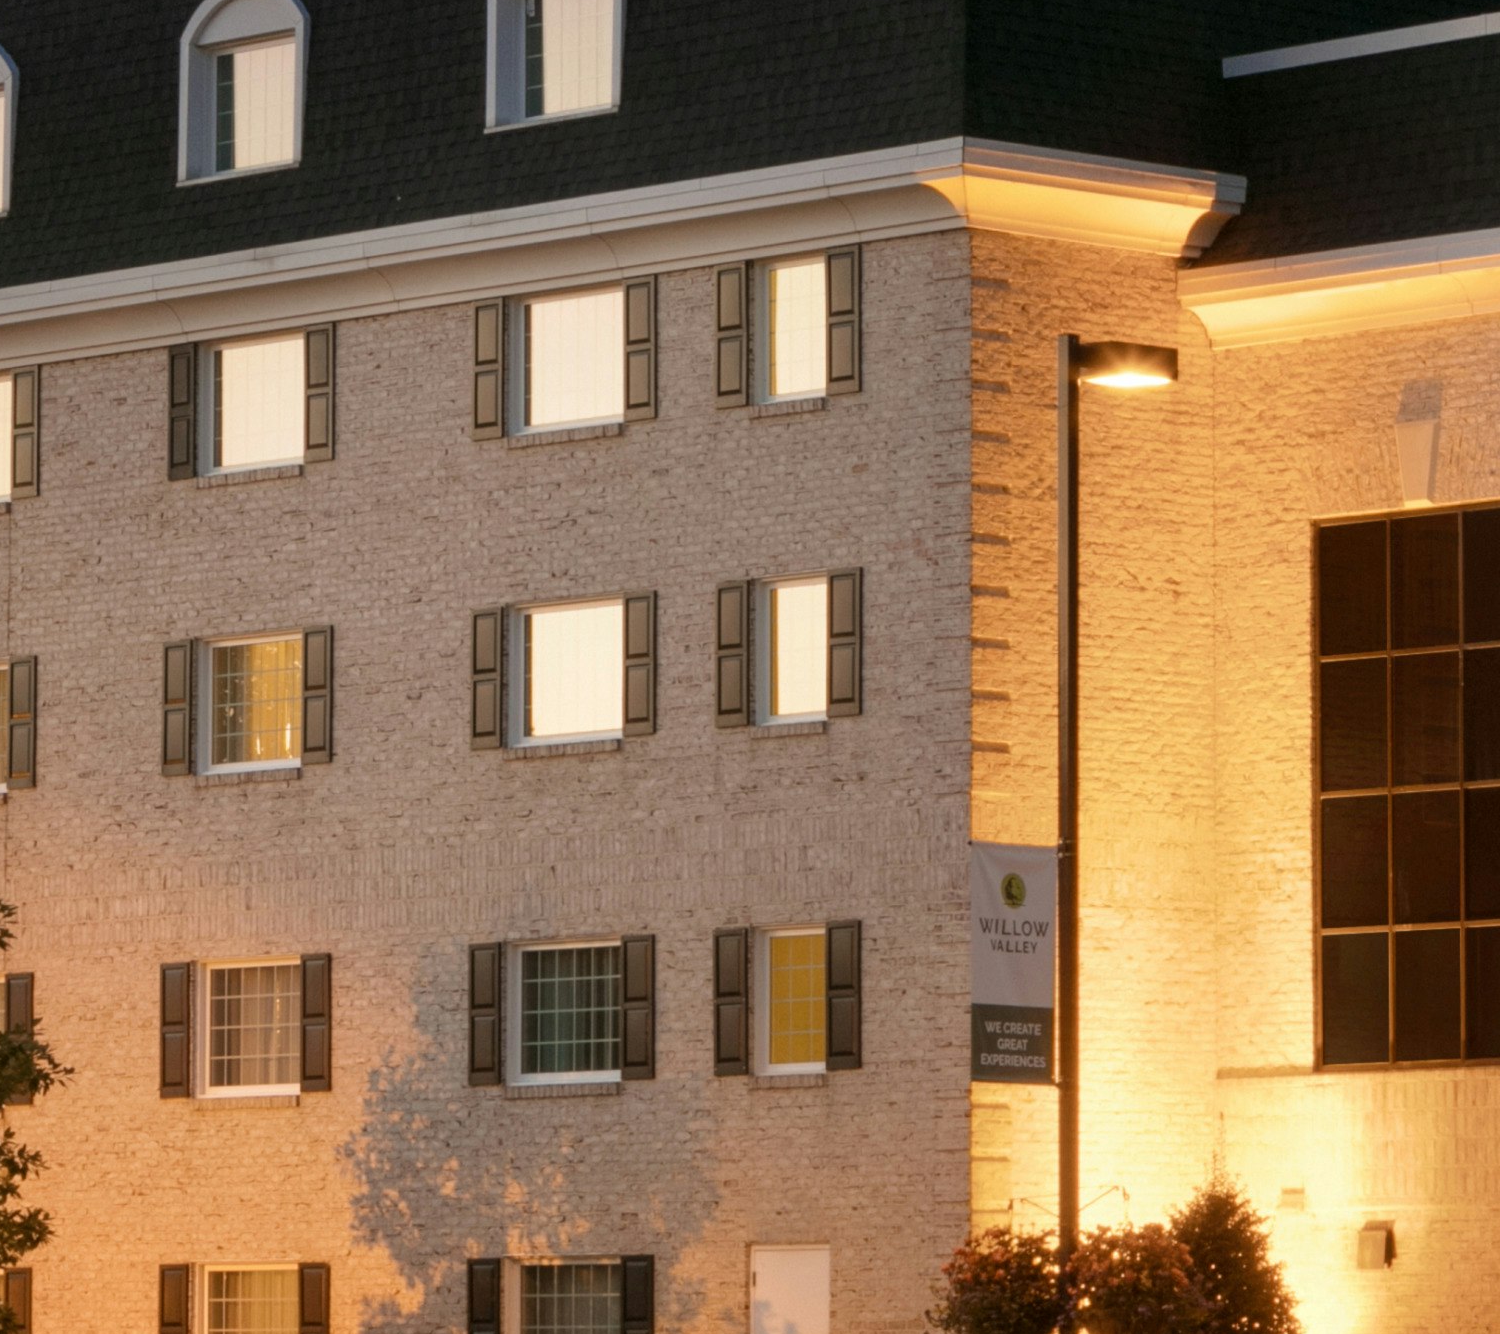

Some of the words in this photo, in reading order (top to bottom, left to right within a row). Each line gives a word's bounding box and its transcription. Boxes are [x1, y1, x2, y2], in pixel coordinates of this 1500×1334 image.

[979, 917, 1049, 937] WILLOW
[990, 938, 1038, 954] VALLEY
[984, 1021, 1002, 1033] WE
[1003, 1022, 1042, 1036] CREATE
[997, 1038, 1029, 1051] GREAT
[980, 1053, 1047, 1068] EXPERIENCES
